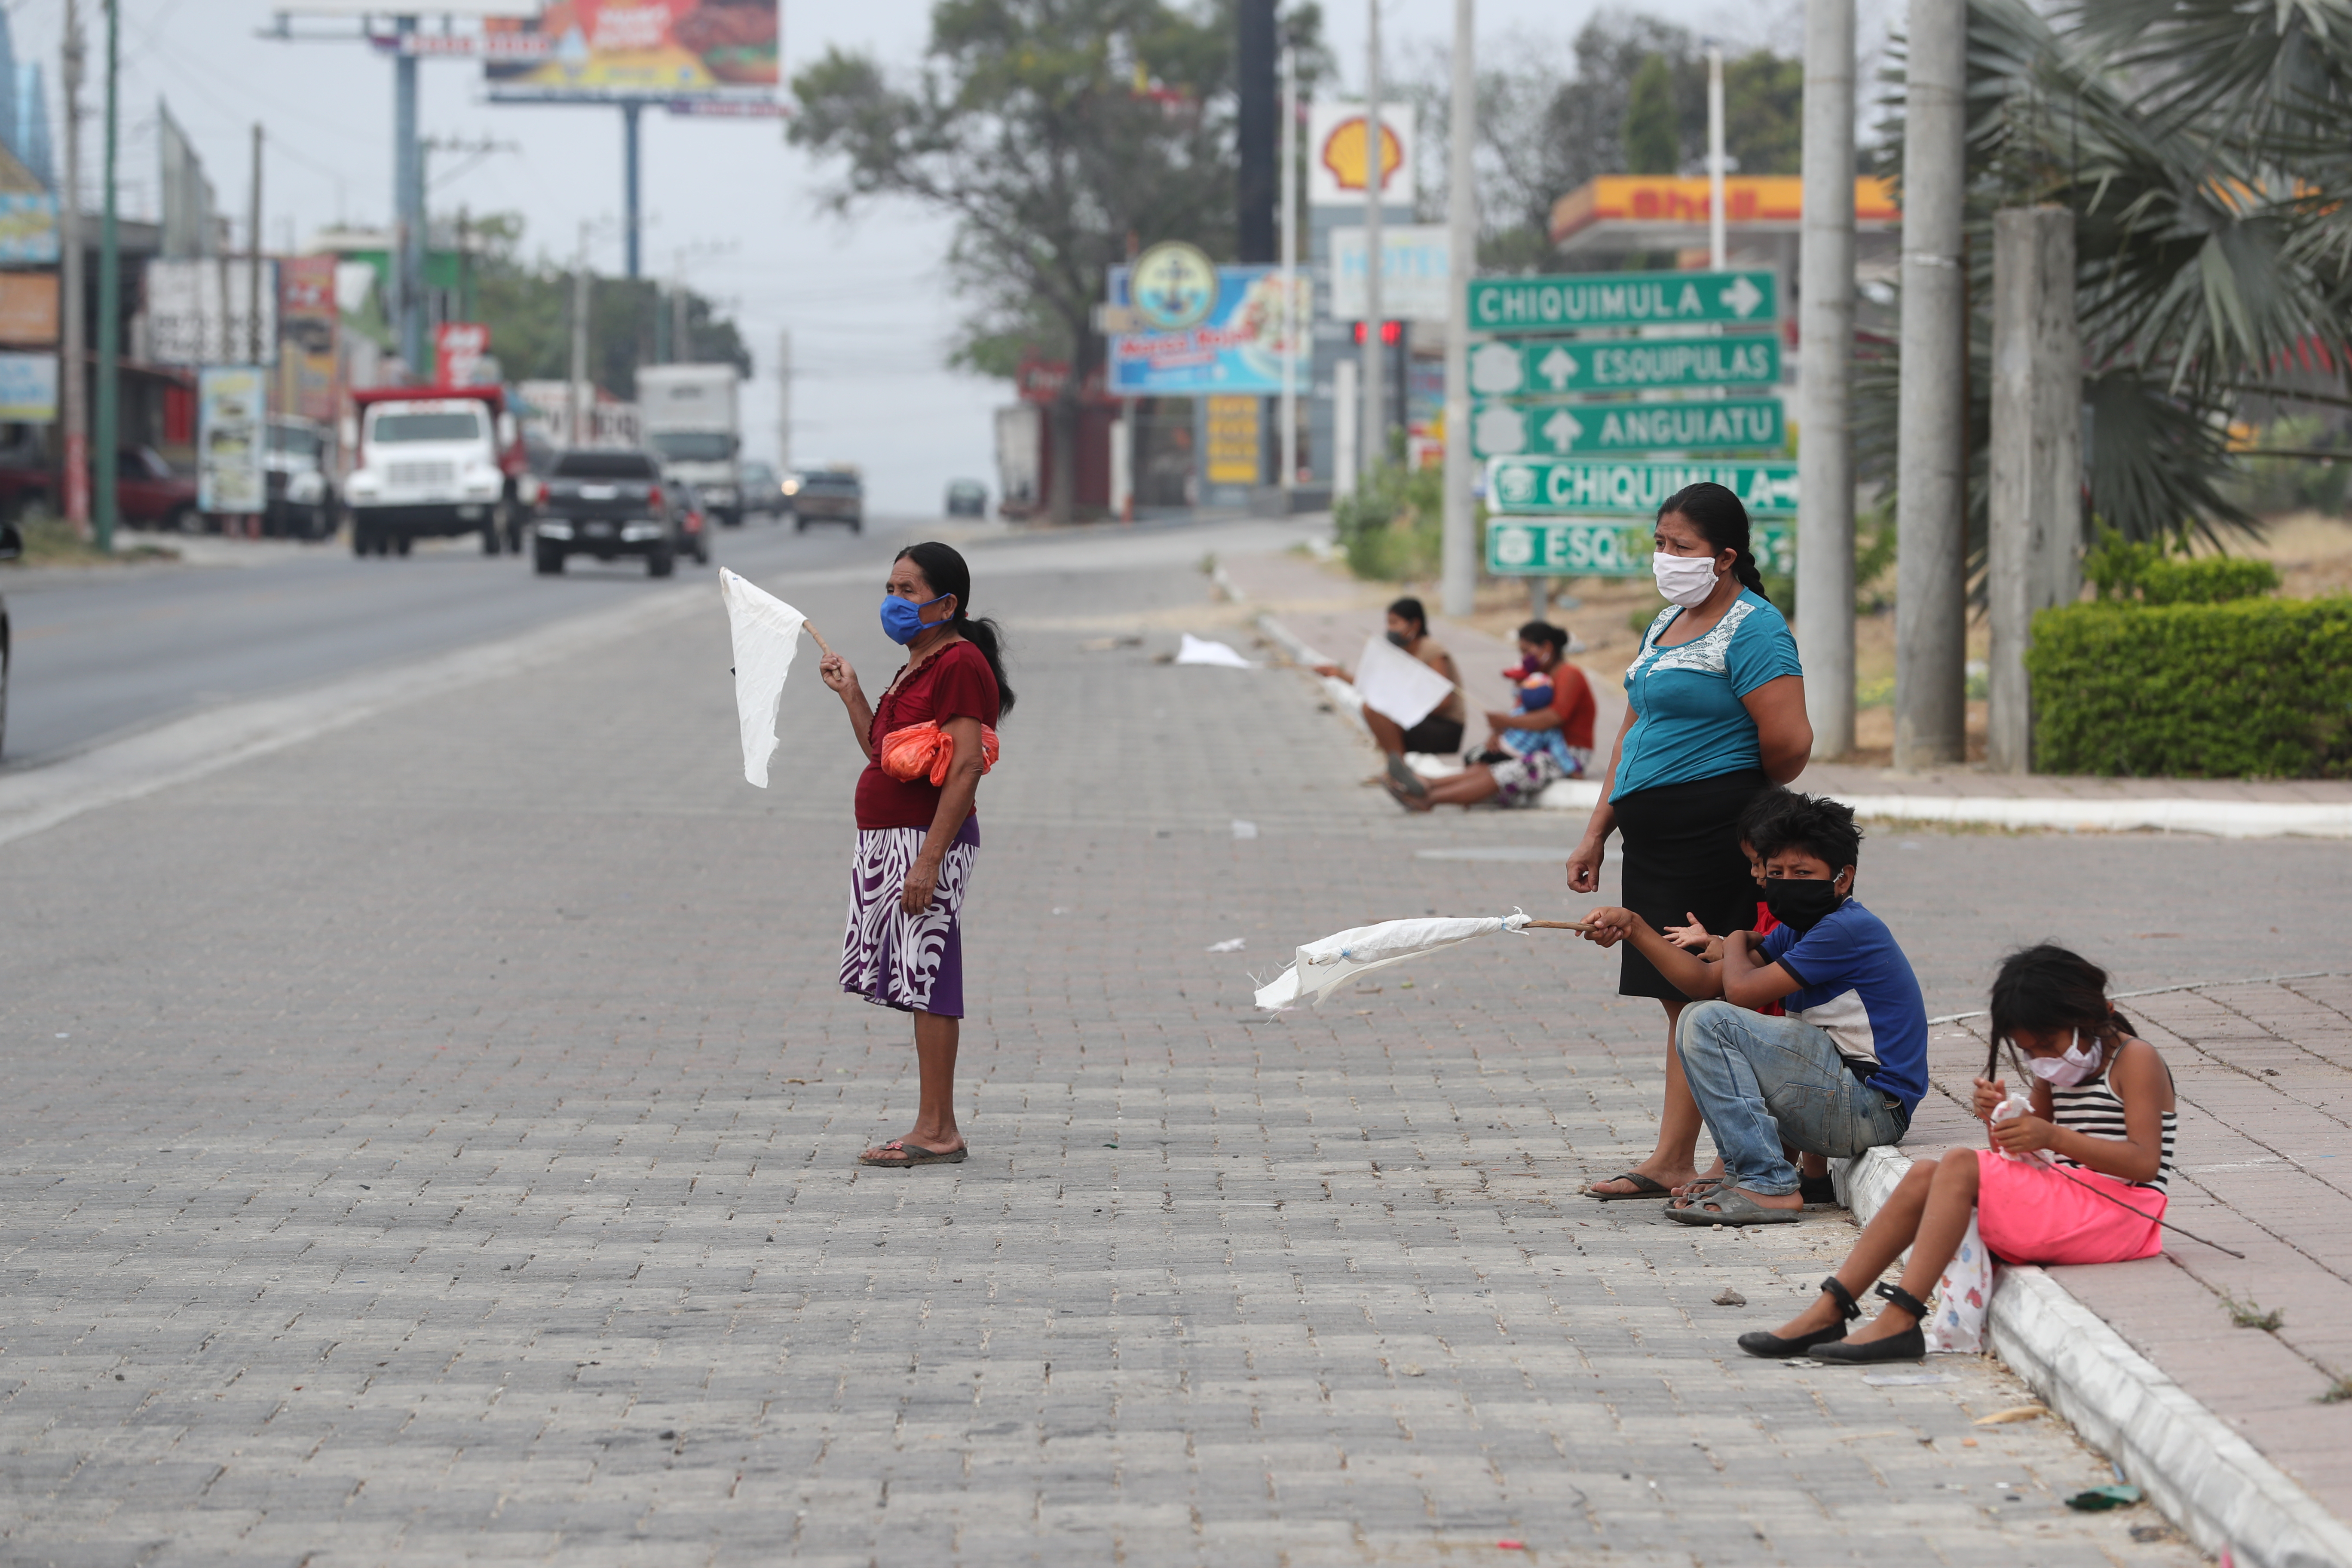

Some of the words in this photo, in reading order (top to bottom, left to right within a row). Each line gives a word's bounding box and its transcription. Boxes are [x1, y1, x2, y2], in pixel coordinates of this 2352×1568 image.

[1477, 281, 1704, 323] CHIQUIMULA
[1592, 344, 1770, 384] ESQUIPULAS
[1599, 407, 1774, 446] ANGUIATU
